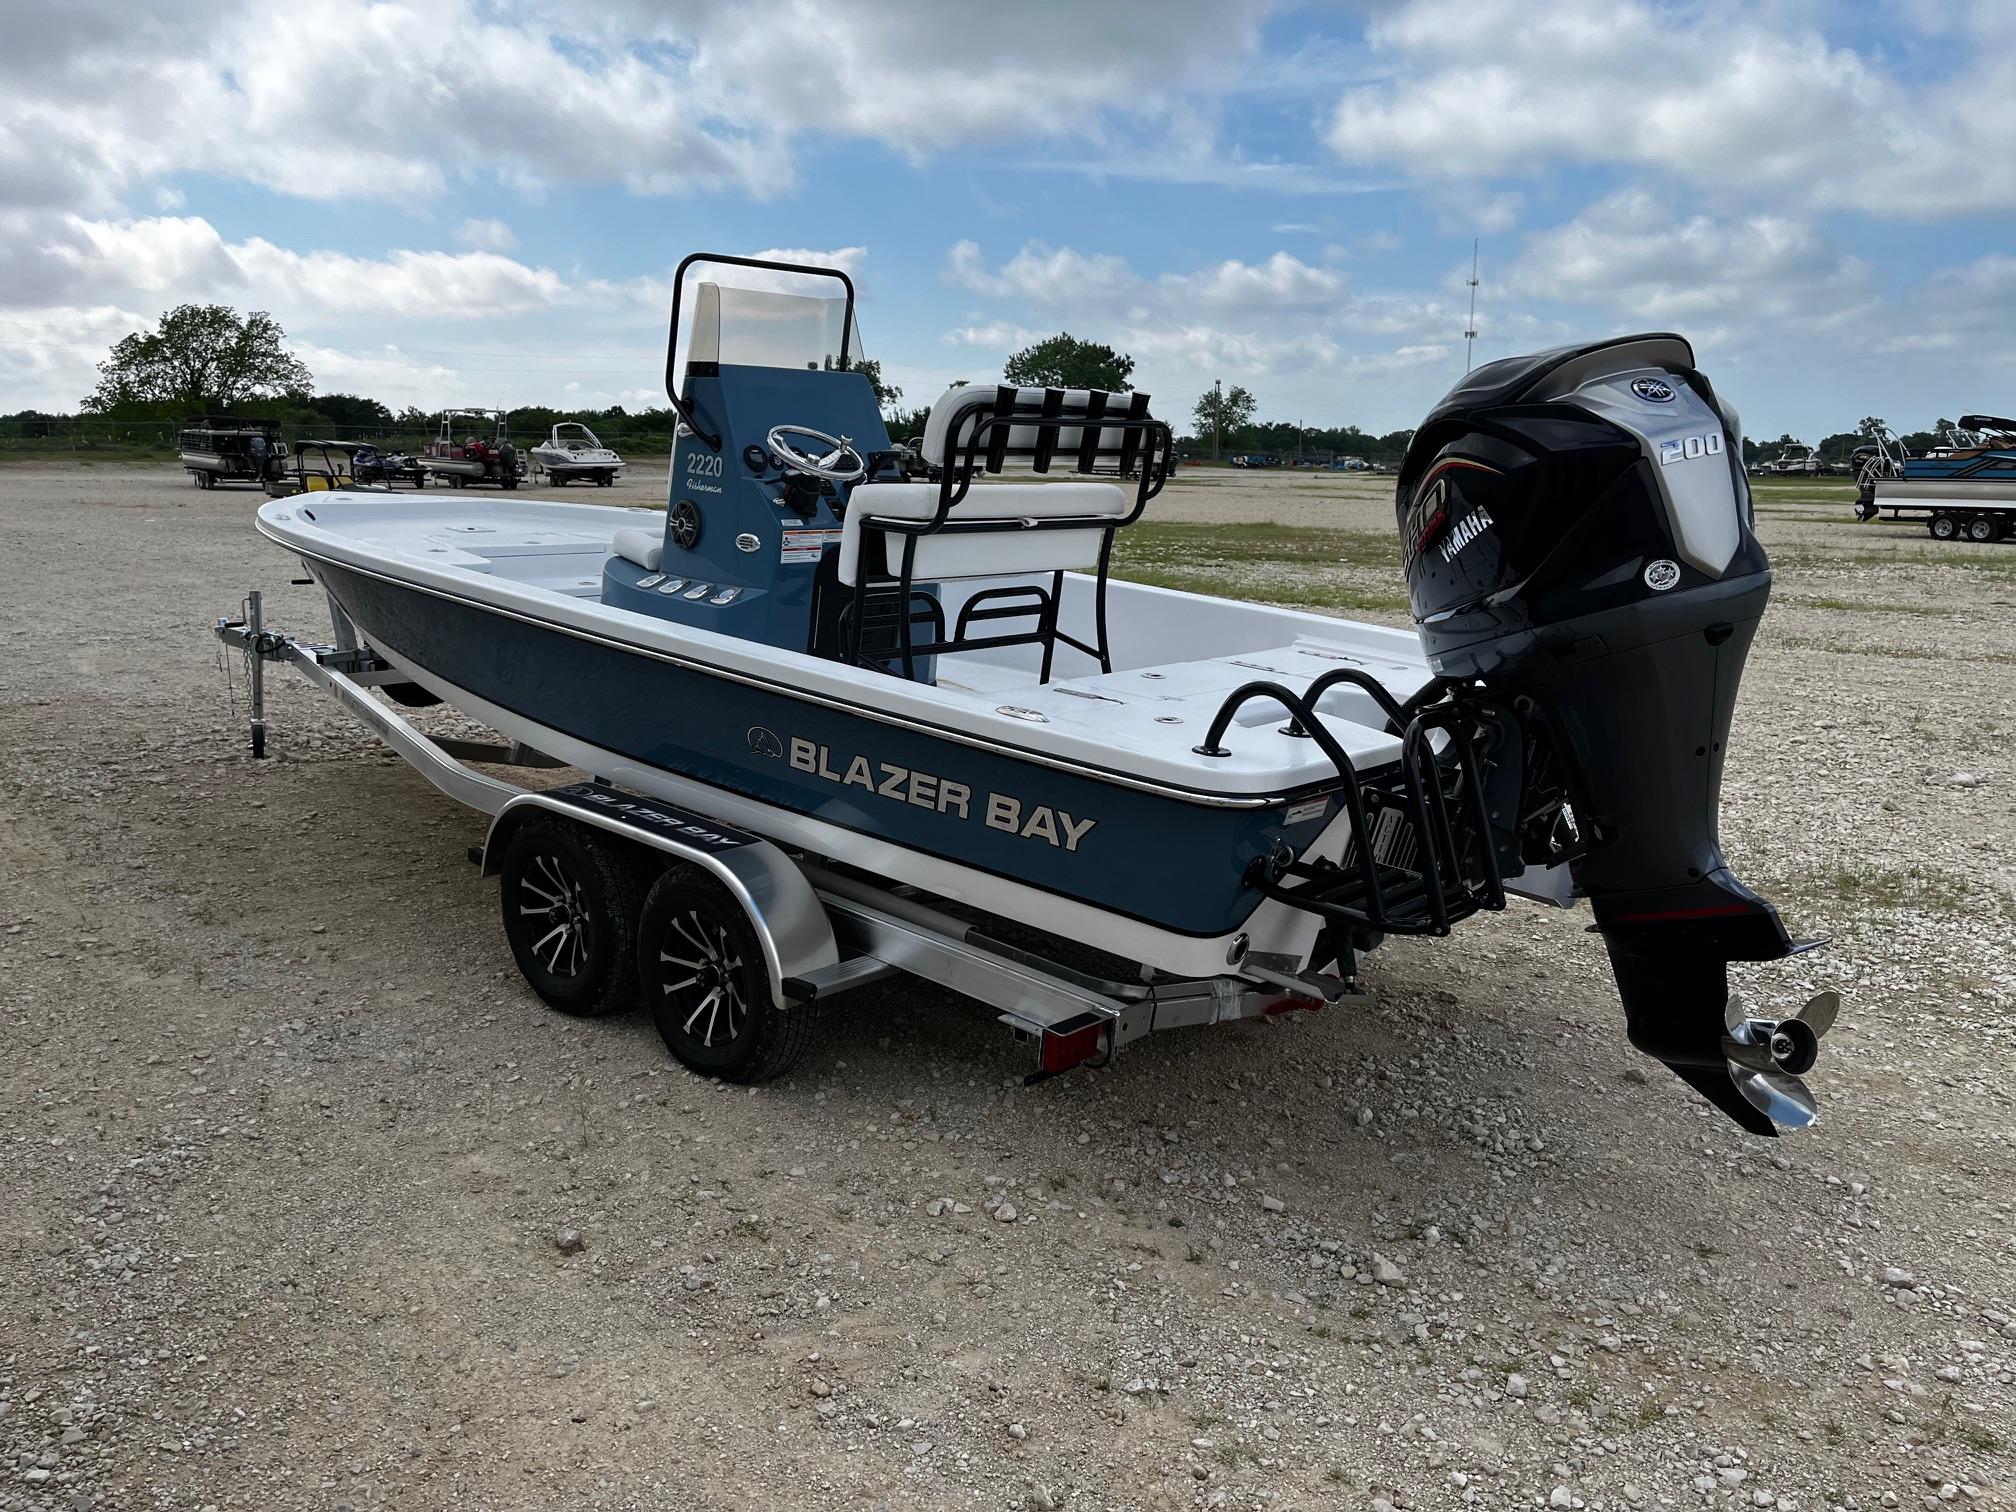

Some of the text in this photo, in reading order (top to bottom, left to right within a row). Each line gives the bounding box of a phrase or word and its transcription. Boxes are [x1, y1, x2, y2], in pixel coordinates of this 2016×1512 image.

[687, 453, 722, 477] 2220
[1661, 432, 1724, 466] 200
[1438, 505, 1493, 562] YAMAHA
[789, 735, 970, 819] BLAZER
[985, 791, 1100, 852] BAY
[582, 794, 743, 845] BLAZER BAY
